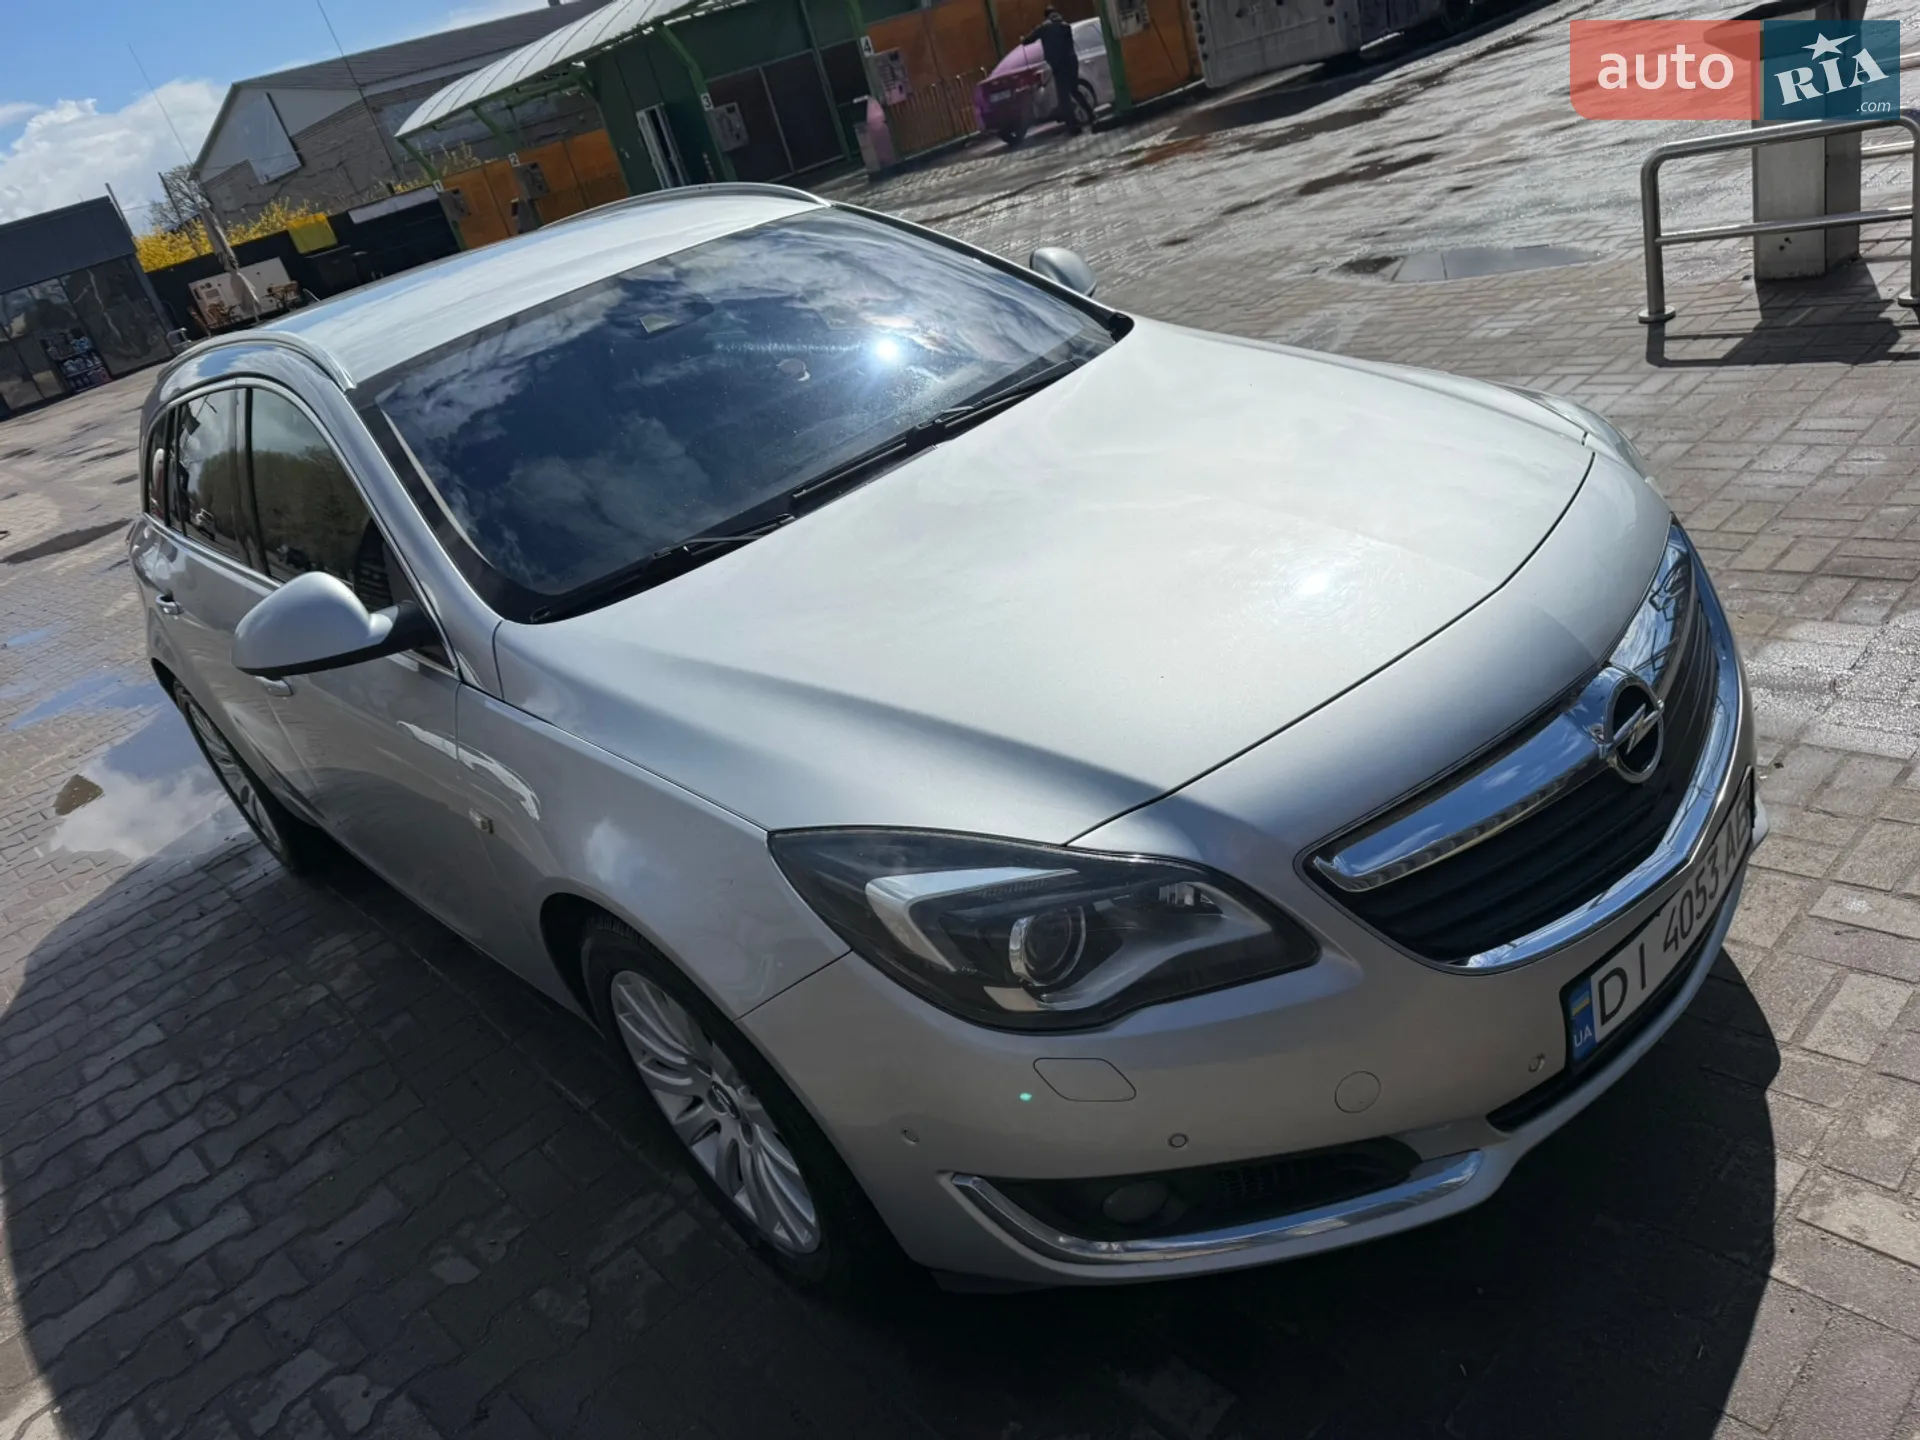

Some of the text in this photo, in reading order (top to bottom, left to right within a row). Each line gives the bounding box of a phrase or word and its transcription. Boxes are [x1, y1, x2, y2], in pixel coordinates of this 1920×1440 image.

[1598, 942, 1647, 1026] DI
[1663, 844, 1719, 953] 4053
[1573, 1024, 1593, 1048] UA
